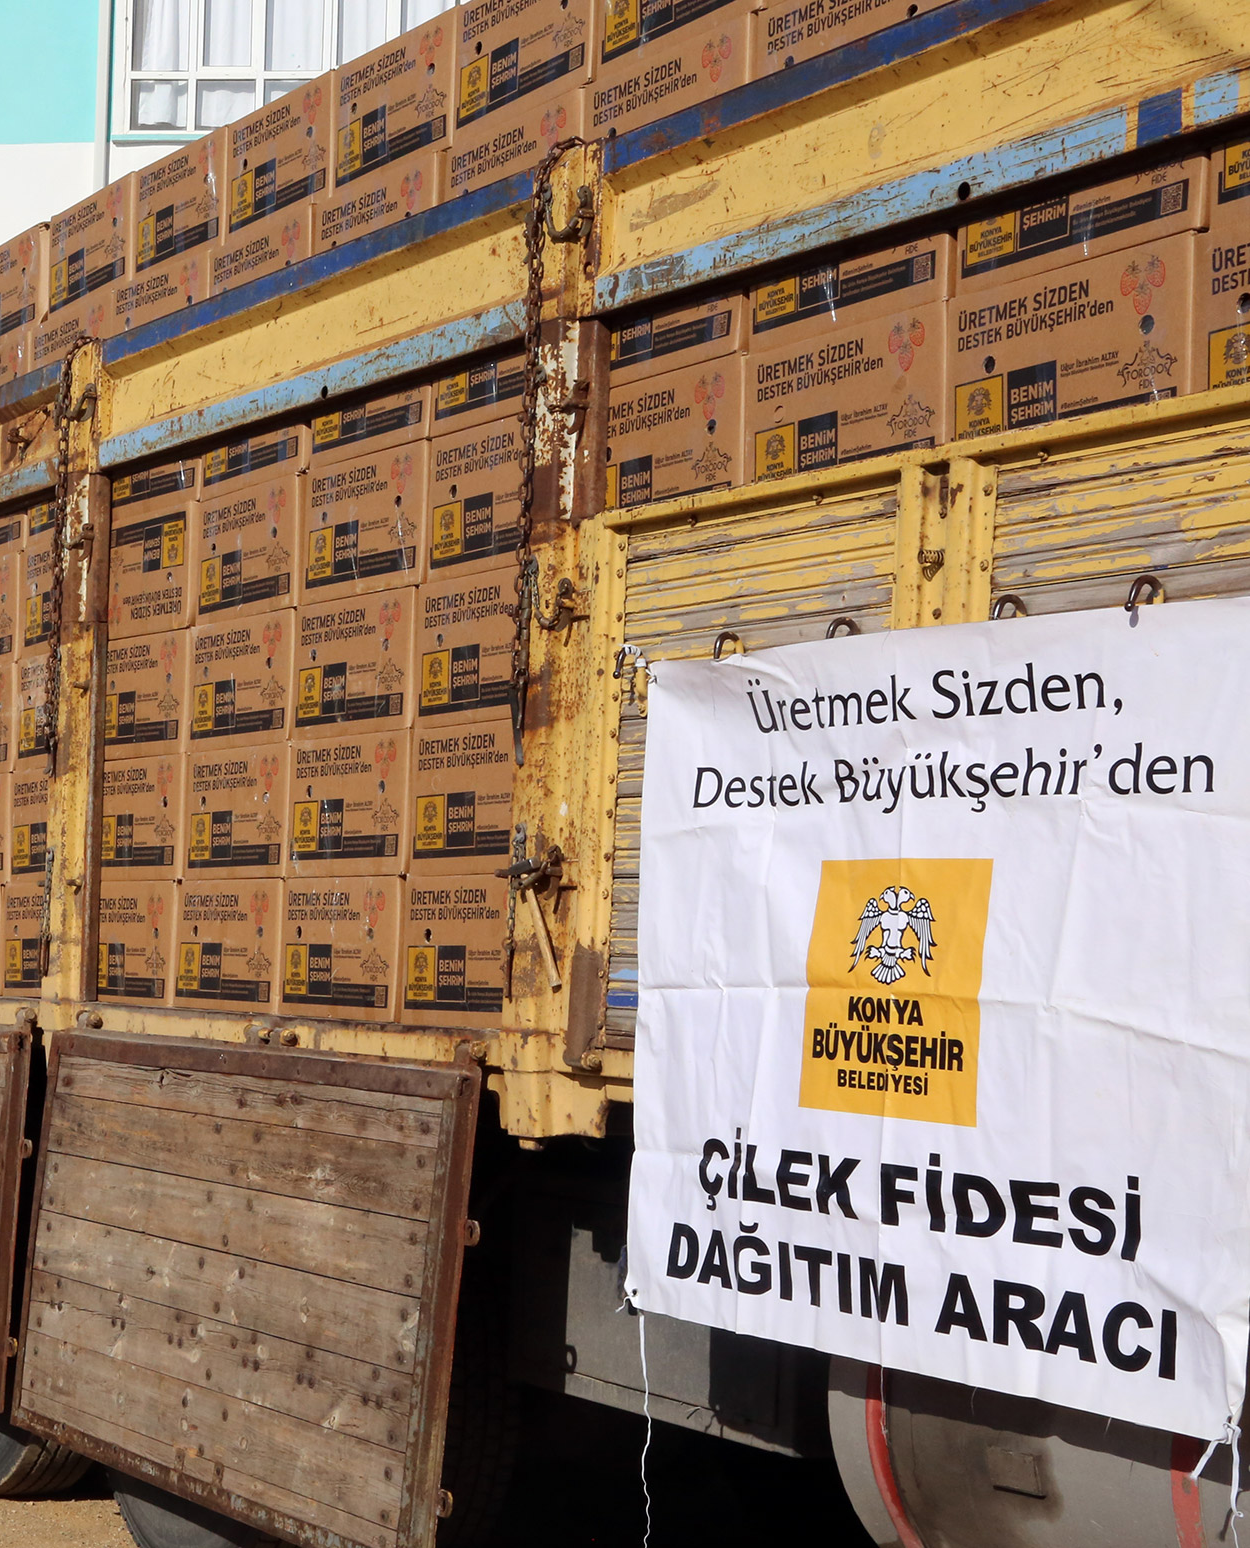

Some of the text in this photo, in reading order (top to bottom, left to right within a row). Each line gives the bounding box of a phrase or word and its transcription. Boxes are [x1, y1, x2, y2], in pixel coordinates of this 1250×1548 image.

[463, 21, 489, 42] DESTEK
[767, 26, 804, 55] DESTEK
[341, 47, 406, 92] ÜRETMEK SİZDEN
[593, 73, 641, 111] ÜRETMEK
[650, 57, 682, 91] SİZDEN
[340, 86, 362, 106] DESTEK
[593, 103, 623, 127] DESTEK
[451, 127, 524, 173] ÜRETMEK SİZDEN
[451, 170, 476, 188] DESTEK
[322, 187, 387, 226] ÜRETMEK SİZDEN
[321, 223, 343, 241] DESTEK
[969, 232, 1012, 254] BÜYÜKŞEHİR
[980, 227, 1002, 240] KONYA
[958, 279, 1089, 332] ÜRETMEK SİZDEN
[958, 300, 1114, 352] DESTEK BÜYÜKŞEHİR'den
[758, 338, 864, 384] ÜRETMEK SİZDEN
[758, 357, 883, 403] DESTEK BÜYÜKŞEHİR'den
[637, 389, 675, 411] SİZDEN
[620, 406, 690, 436] BÜYÜKŞEHİR'den
[968, 417, 990, 428] KONYA
[436, 432, 514, 466] ÜRETMEK SİZDEN
[436, 465, 462, 482] DESTEK
[767, 462, 784, 470] KONYA
[312, 465, 376, 493] ÜRETMEK SİZDEN
[312, 493, 334, 508] DESTEK
[425, 585, 500, 614] ÜRETMEK SİZDEN
[302, 609, 366, 632] ÜRETMEK SİZDEN
[425, 614, 450, 629] DESTEK
[195, 629, 250, 651] ÜRETMEK SİZDEN
[302, 630, 323, 646] DESTEK
[746, 663, 1125, 733] Üretmek Sizden,
[297, 745, 361, 764] ÜRETMEK SİZDEN
[419, 734, 495, 756] ÜRETMEK SİZDEN
[193, 761, 248, 779] ÜRETMEK SİZDEN
[297, 766, 318, 779] DESTEK
[418, 752, 508, 771] DESTEK BÜYÜKŞEHİR'den
[692, 742, 1214, 814] Destek Büyükşehir'den
[289, 890, 349, 906] ÜRETMEK SİZDEN
[411, 889, 486, 905] ÜRETMEK SİZDEN
[288, 908, 310, 920] DESTEK
[411, 907, 500, 924] DESTEK BÜYÜKŞEHİR'den
[847, 996, 924, 1027] KONYA
[811, 1027, 965, 1072] BÜYÜKŞEHİR
[836, 1068, 930, 1097] BELEDİYESİ
[698, 1128, 1141, 1262] ÇİLEK FİDESİ
[666, 1218, 1178, 1380] DAĞITIM ARACI
